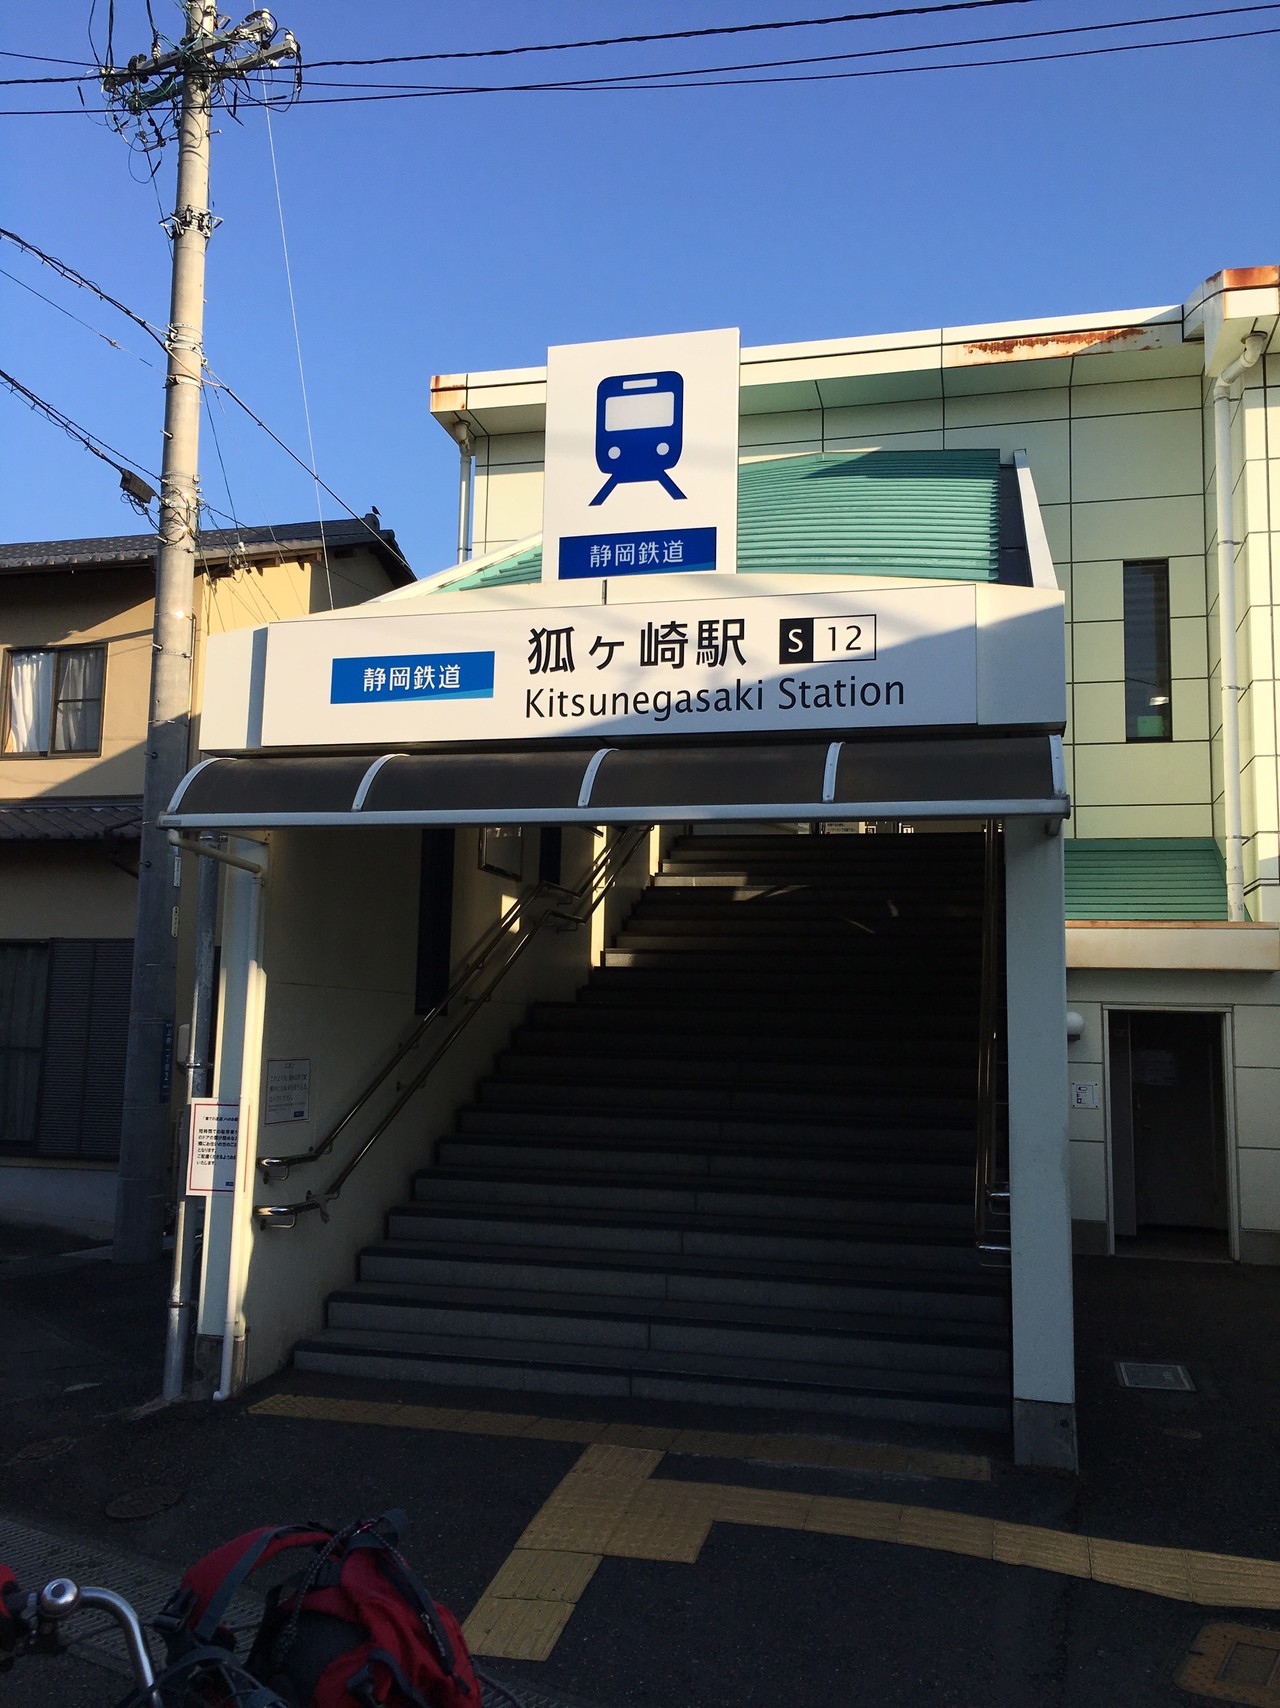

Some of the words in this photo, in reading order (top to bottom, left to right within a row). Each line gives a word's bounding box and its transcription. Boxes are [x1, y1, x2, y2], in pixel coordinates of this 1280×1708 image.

[590, 539, 684, 568] 静岡鉄道
[528, 618, 747, 675] 狐ヶ崎駅
[788, 628, 803, 653] S
[828, 625, 862, 652] 12
[362, 663, 462, 693] 静岡鉄道
[526, 679, 763, 721] Kitsunegasaki
[778, 676, 904, 710] Station
